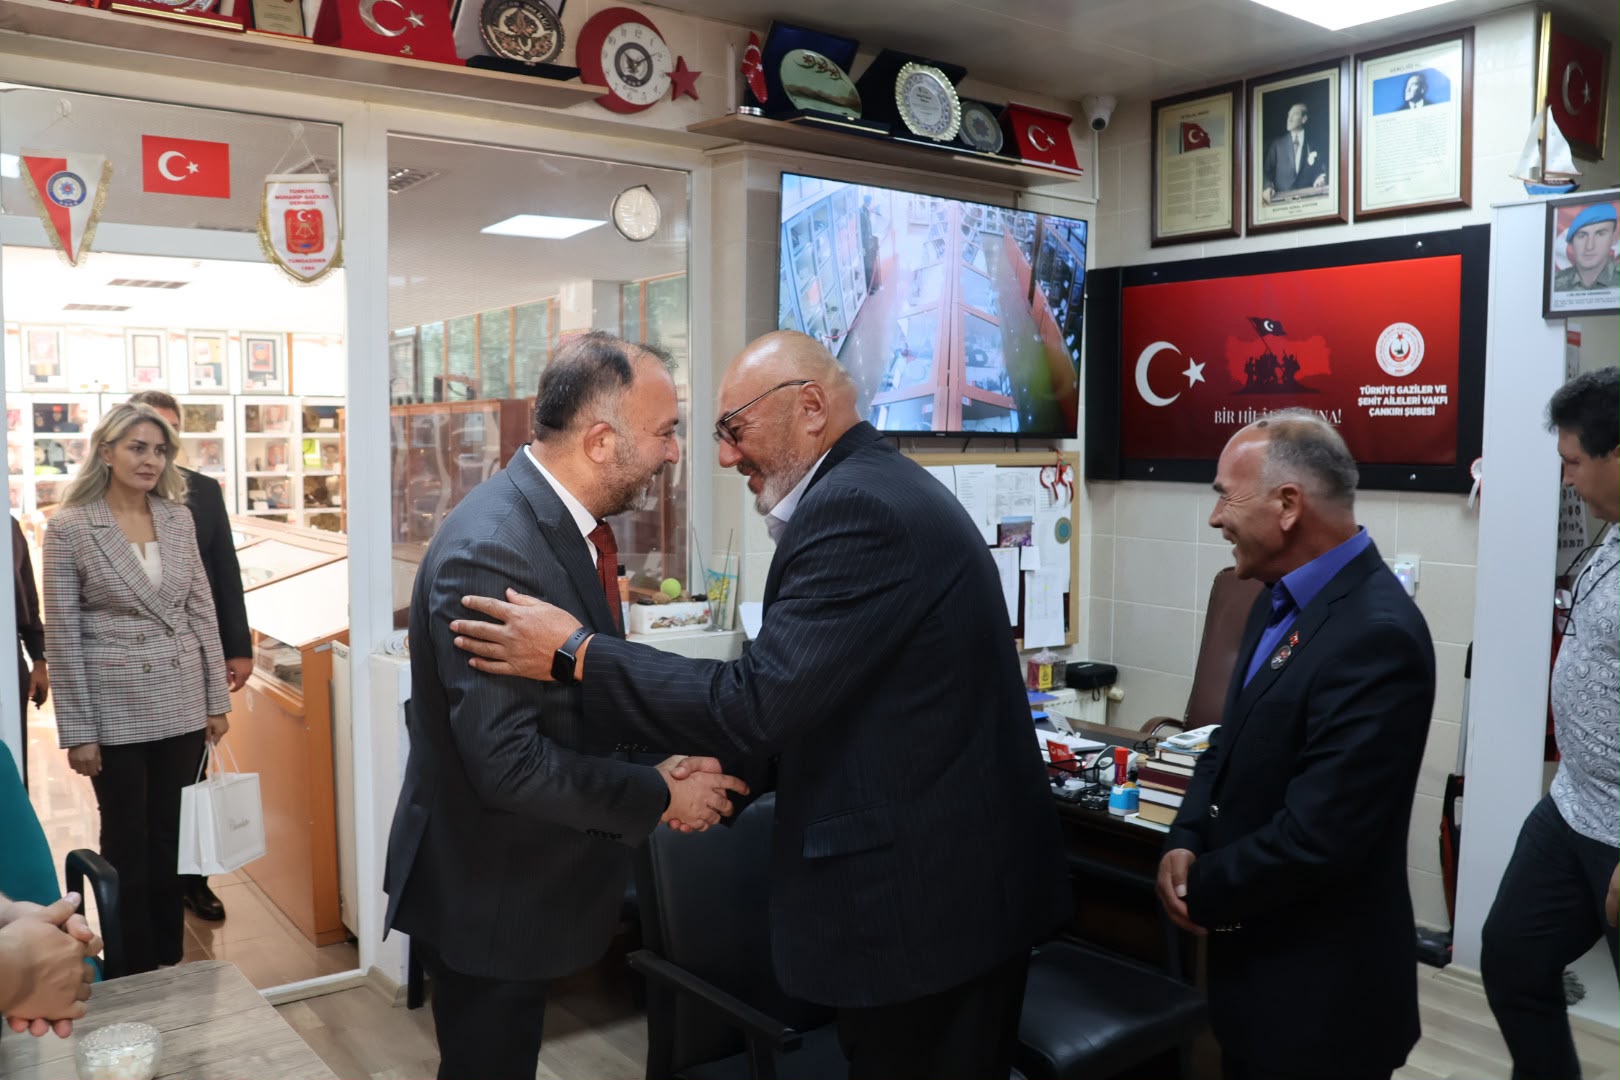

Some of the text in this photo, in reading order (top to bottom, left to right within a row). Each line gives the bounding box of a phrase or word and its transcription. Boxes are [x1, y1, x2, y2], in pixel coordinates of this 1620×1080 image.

[1359, 383, 1447, 395] TÜRKİYE GAZİLER VE
[1358, 395, 1448, 407] ŞEHİT AİLELERİ VAKFI
[1215, 406, 1235, 424] BİR
[1369, 405, 1435, 417] ÇANKIRI ŞUBESİ
